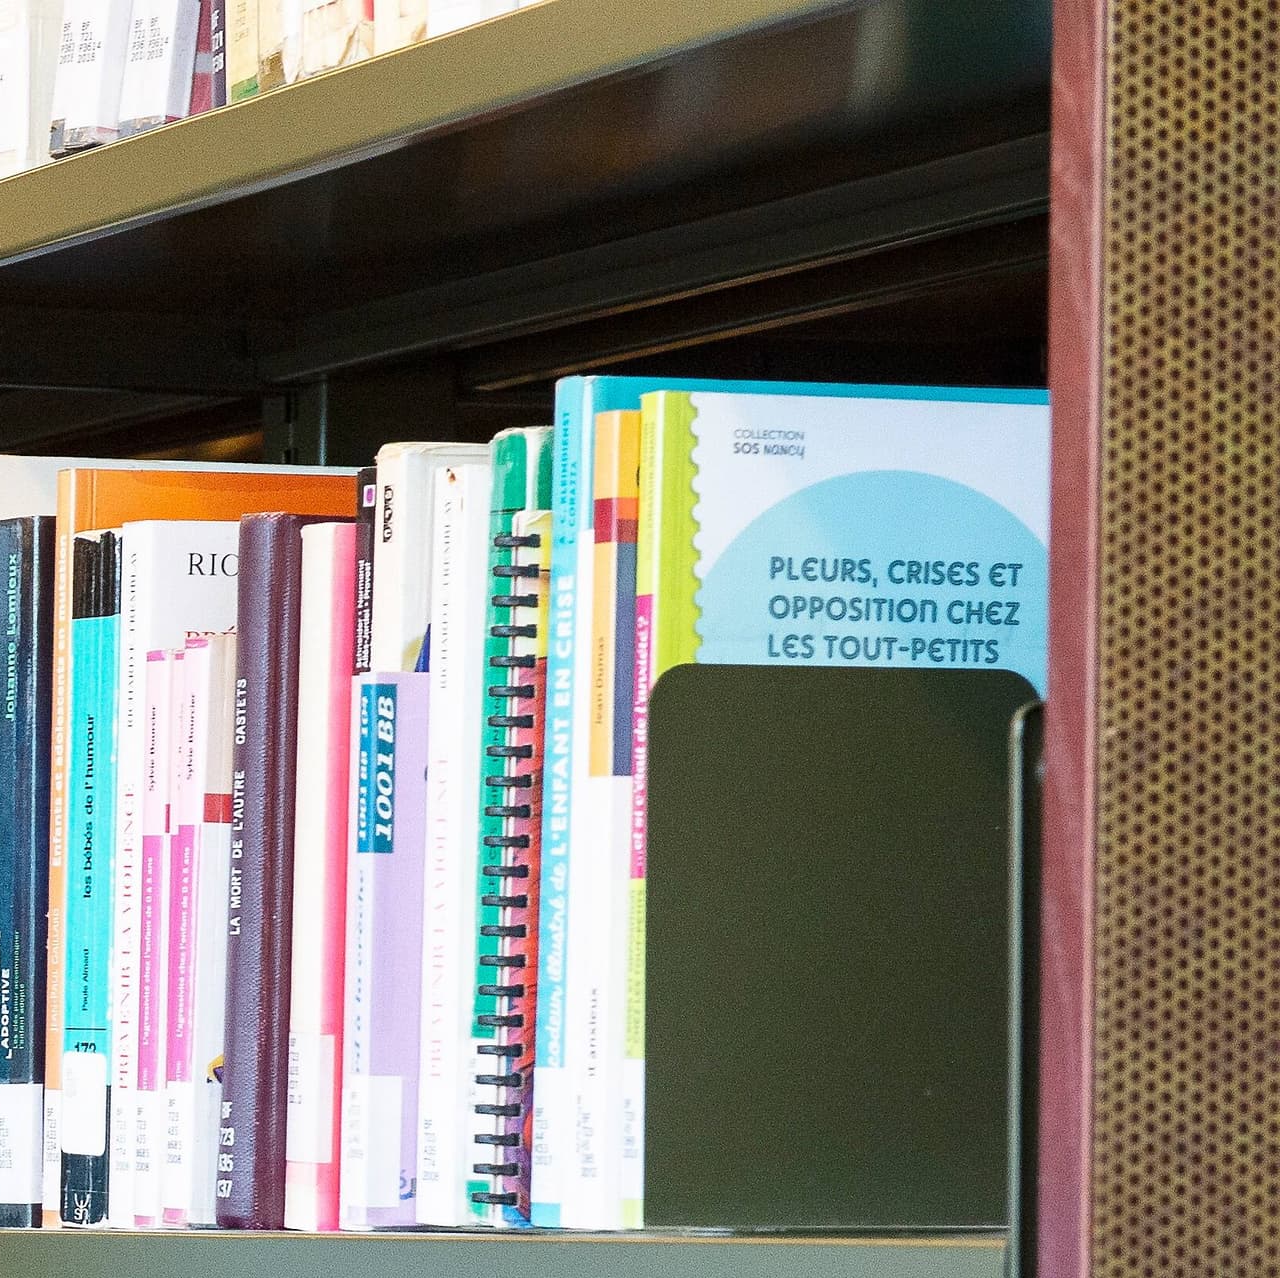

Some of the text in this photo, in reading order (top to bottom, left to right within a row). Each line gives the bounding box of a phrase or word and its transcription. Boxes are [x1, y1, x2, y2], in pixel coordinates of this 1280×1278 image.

[187, 552, 239, 577] RIC
[769, 556, 1023, 589] PLEURS, CRISES ET
[5, 553, 18, 722] Johanne Lemieux
[768, 594, 1021, 626] OPPOSITION CHEZ
[767, 634, 999, 664] LES TOUT-PETITS
[148, 704, 158, 792] Sylvie Bourcier
[185, 694, 196, 781] Sylvie Bourcier
[359, 750, 369, 781] BB
[374, 695, 395, 841] 1001 BB
[229, 677, 247, 936] LA MORT DE L'AUTRE CASTETS
[357, 784, 368, 841] 1001
[0, 968, 12, 1049] ADOPTIVE
